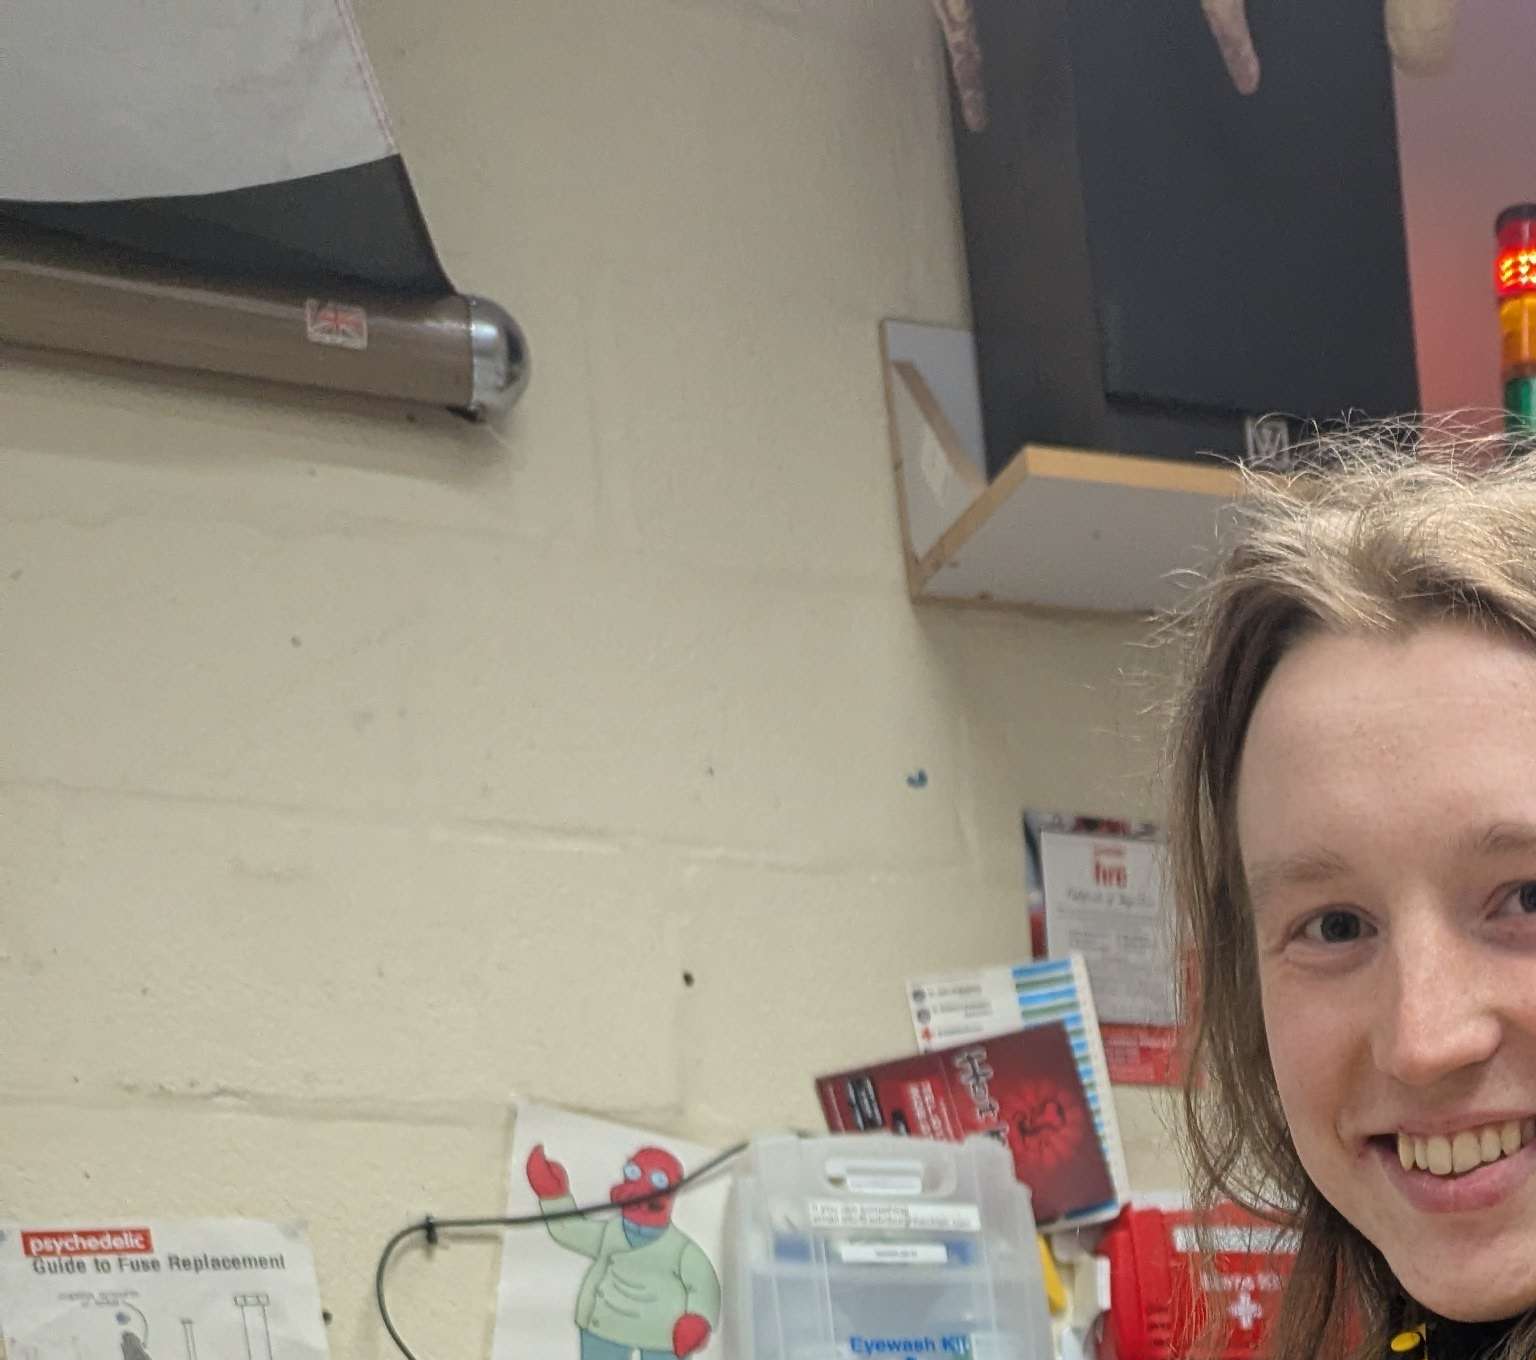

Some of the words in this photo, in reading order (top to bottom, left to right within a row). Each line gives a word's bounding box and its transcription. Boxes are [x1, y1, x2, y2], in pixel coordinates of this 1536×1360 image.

[29, 1232, 146, 1254] psychedelic
[32, 1256, 87, 1274] Guide
[96, 1257, 112, 1273] to
[118, 1256, 161, 1273] Fuse
[168, 1253, 286, 1274] Replacement
[850, 1336, 937, 1356] Eyewash
